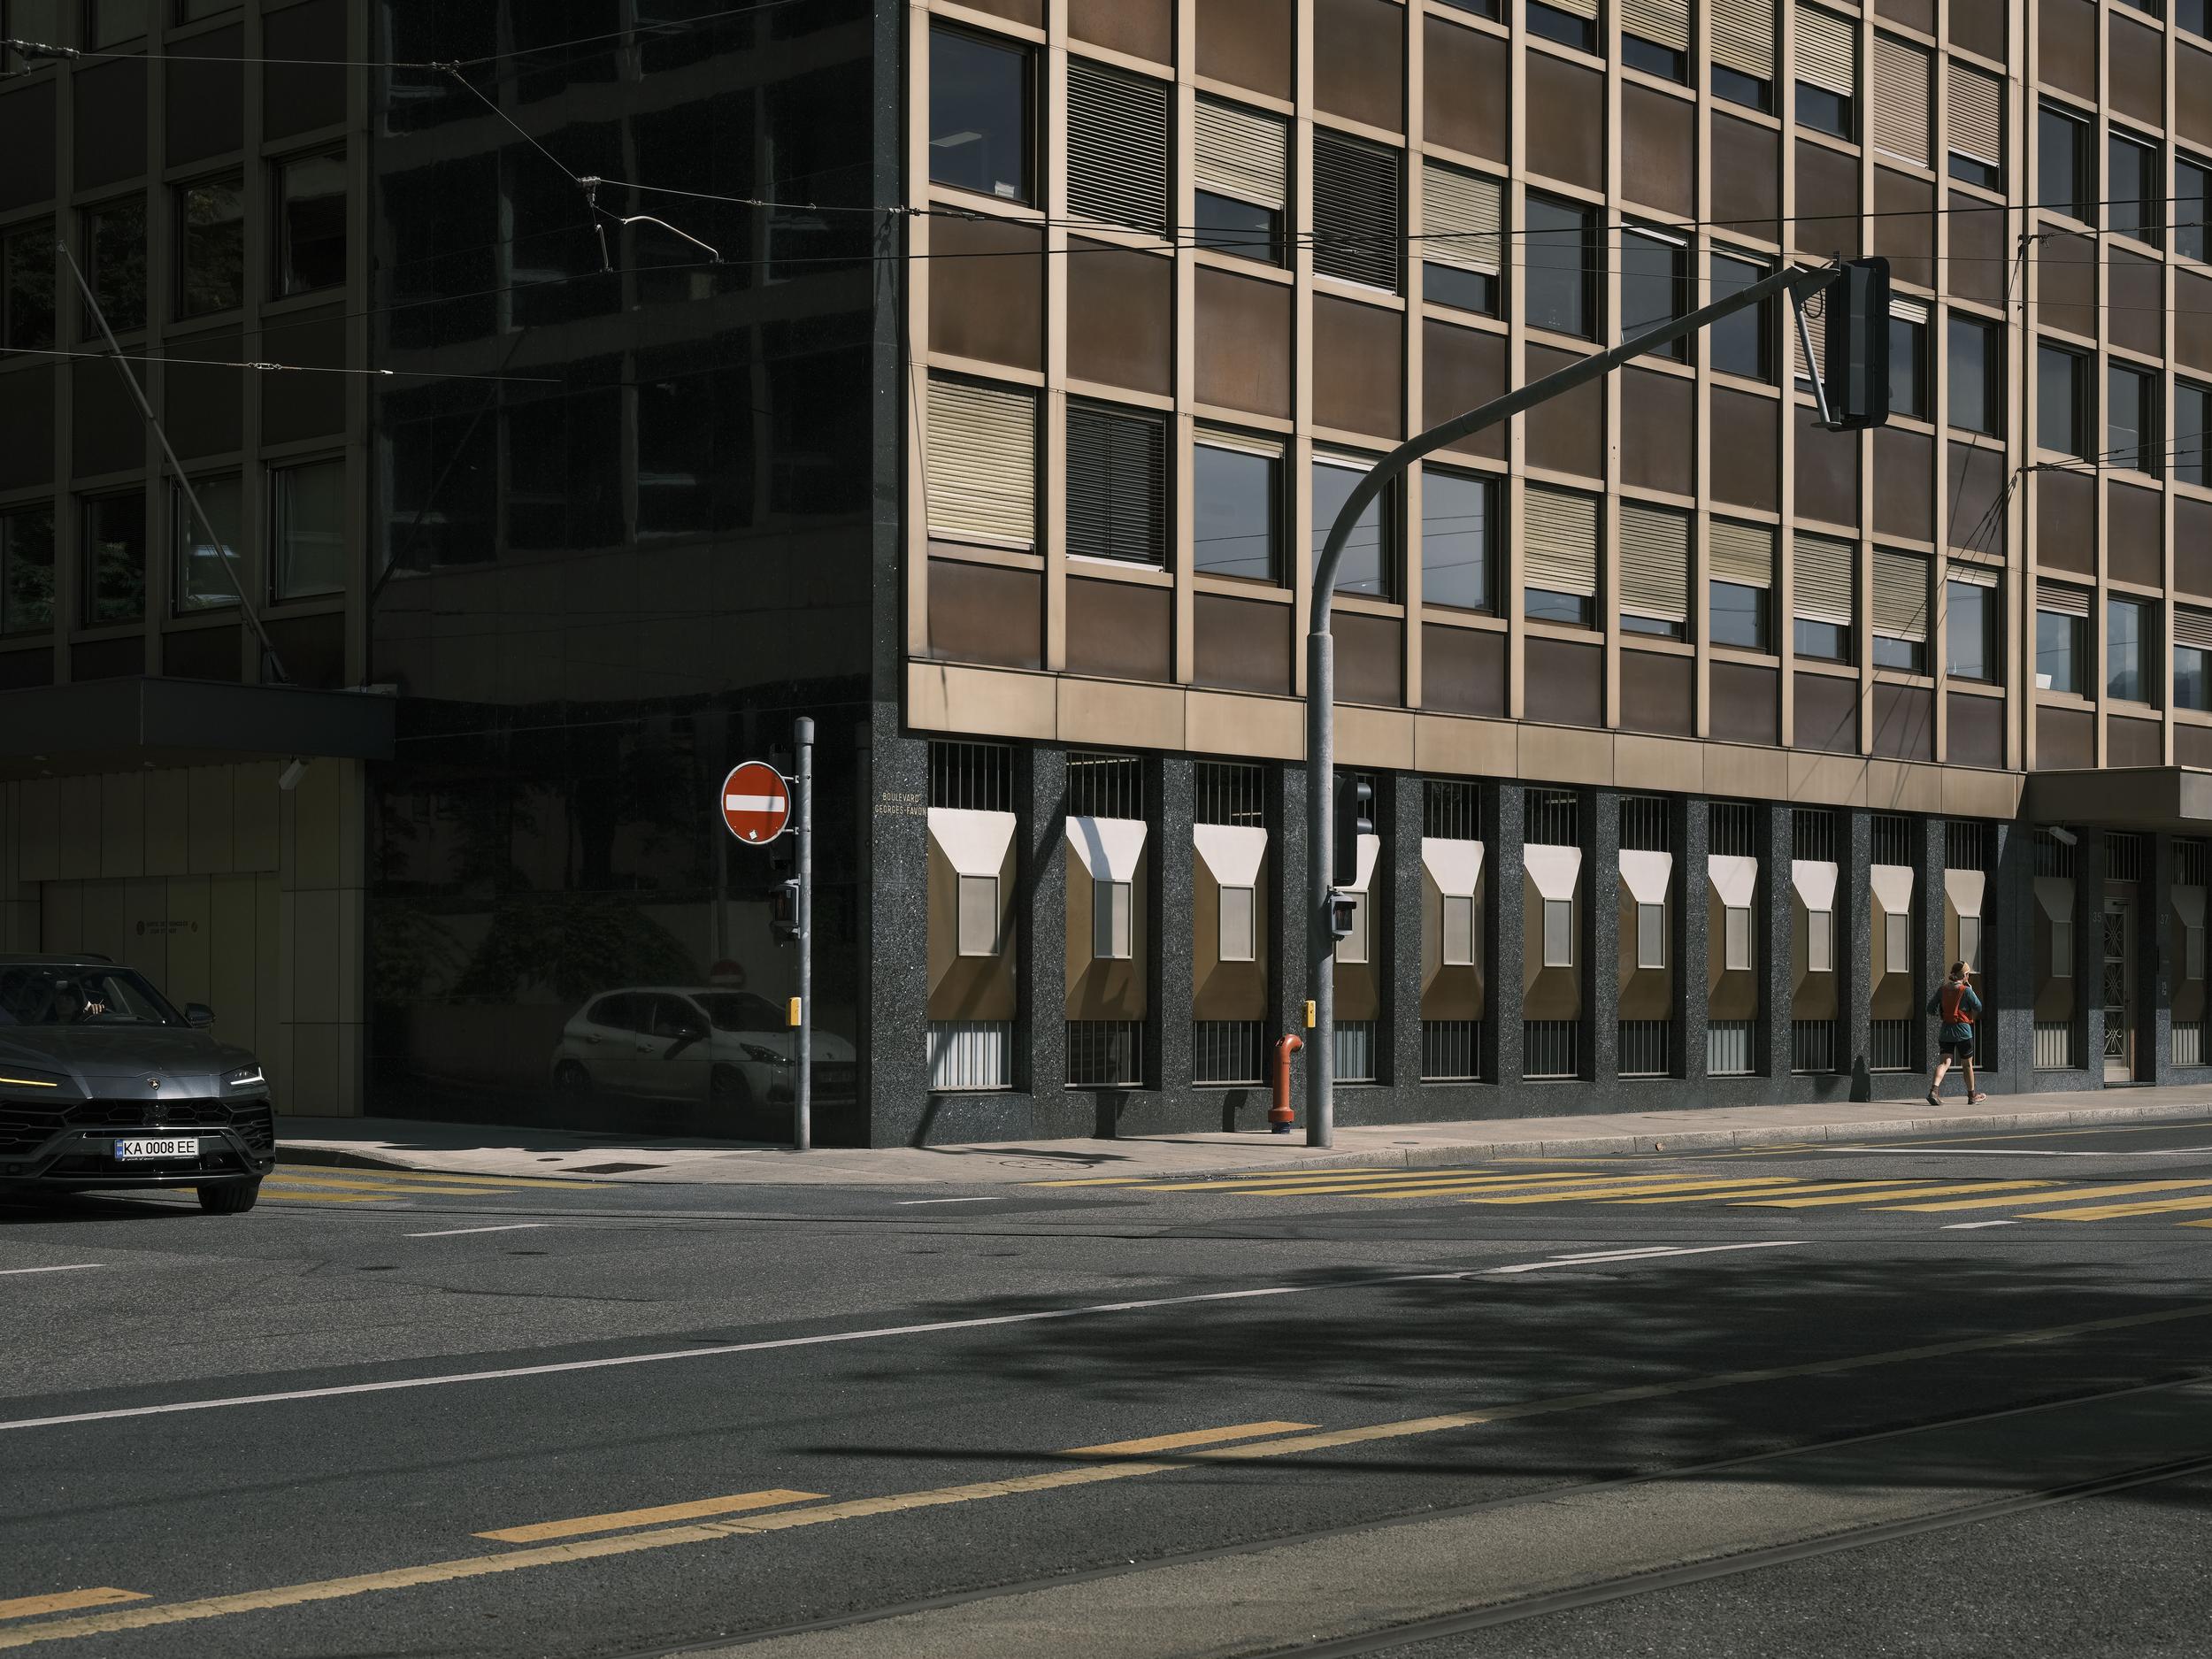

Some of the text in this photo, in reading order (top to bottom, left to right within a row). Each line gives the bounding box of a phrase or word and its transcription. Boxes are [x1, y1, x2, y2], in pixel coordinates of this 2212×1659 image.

[882, 792, 919, 803] BOULEVARD
[875, 804, 927, 817] GEORGES-FAVON
[124, 1141, 195, 1156] KA 0008 EE
